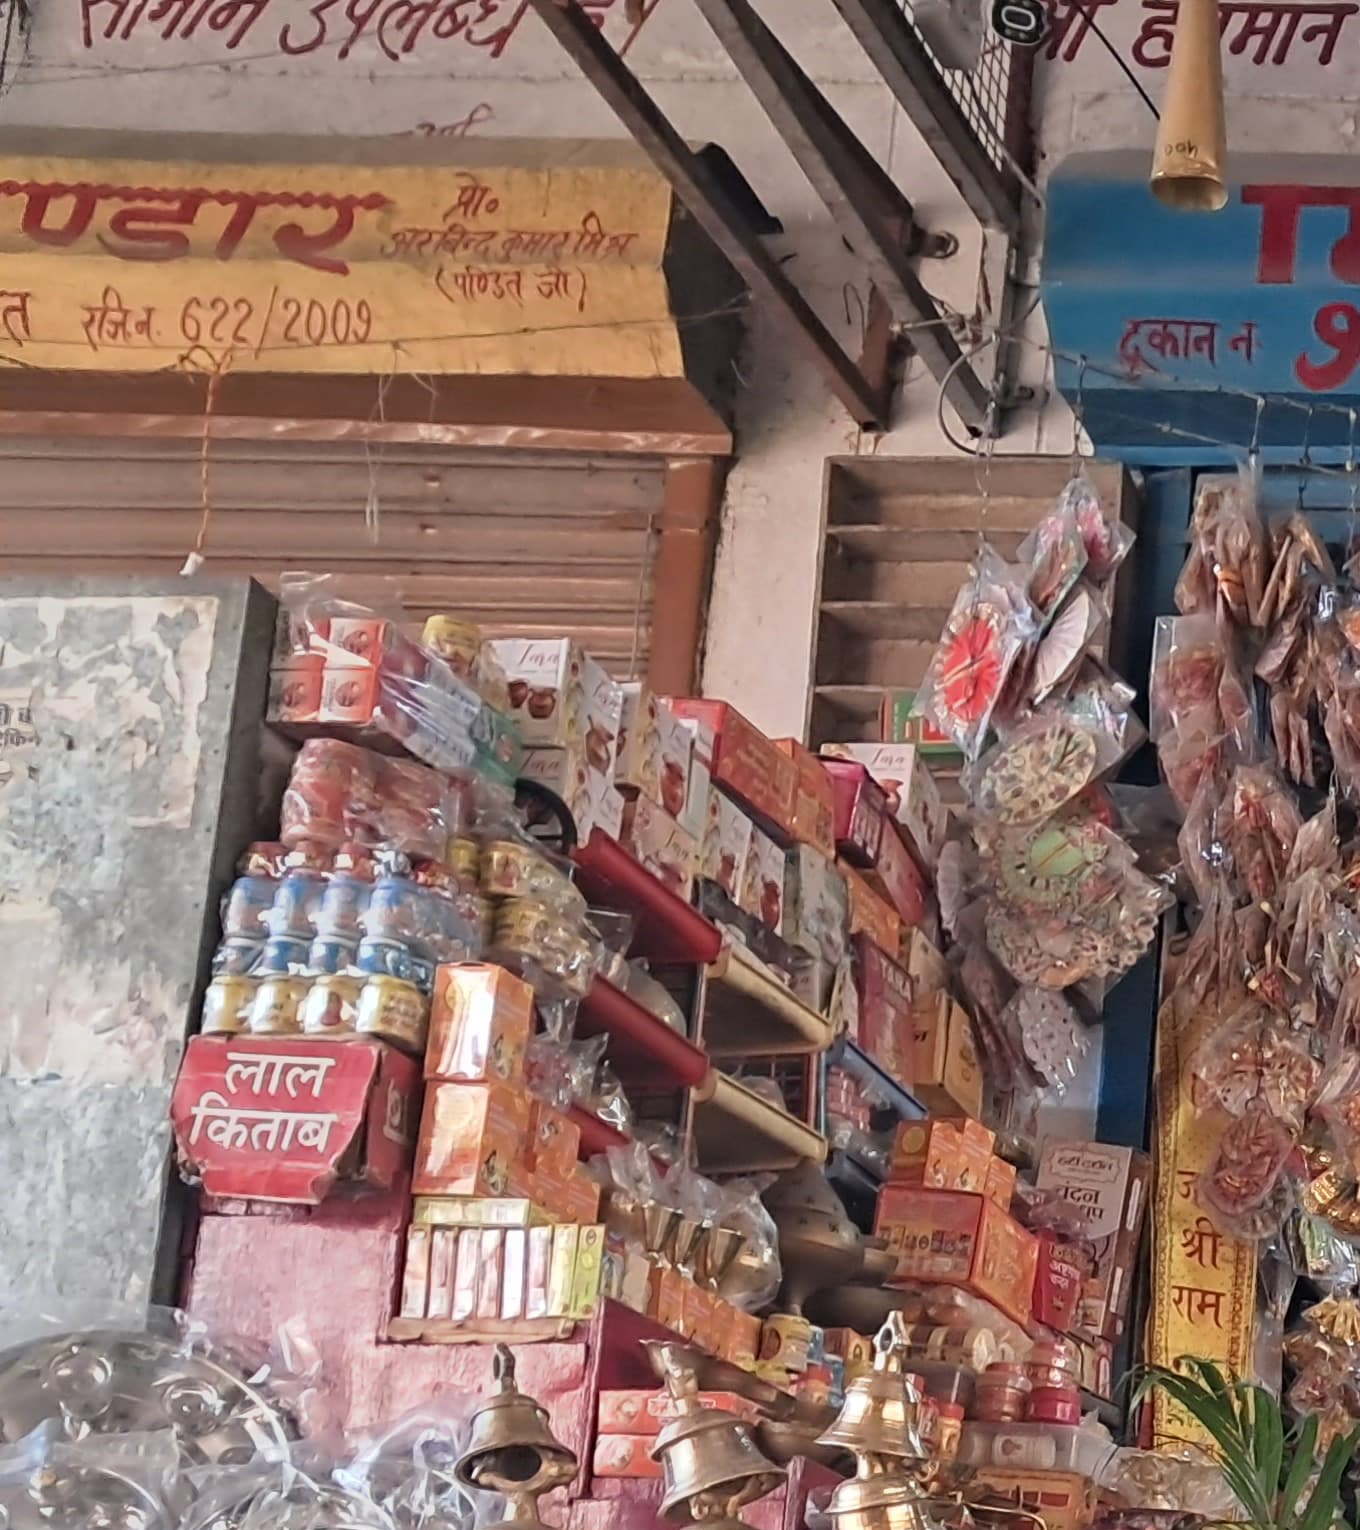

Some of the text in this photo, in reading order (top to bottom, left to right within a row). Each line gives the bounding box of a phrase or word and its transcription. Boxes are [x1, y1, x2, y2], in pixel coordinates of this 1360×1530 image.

[0, 179, 395, 276] ण्डार
[179, 284, 374, 361] 622/2009
[223, 1050, 337, 1100] लाल
[188, 1089, 340, 1155] किताब
[1179, 1216, 1223, 1269] श्री
[1170, 1284, 1227, 1330] राम
